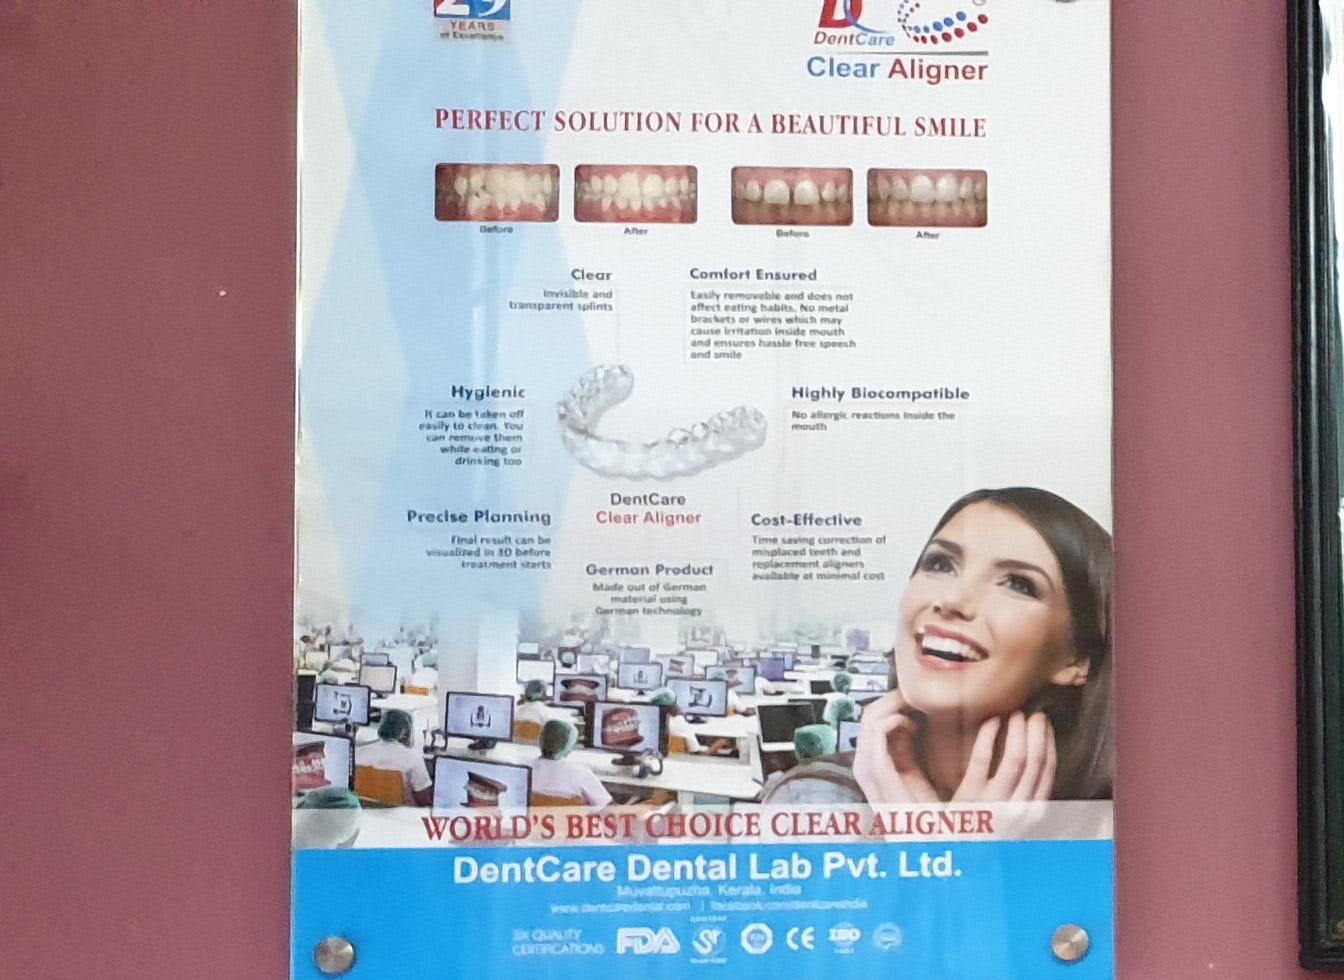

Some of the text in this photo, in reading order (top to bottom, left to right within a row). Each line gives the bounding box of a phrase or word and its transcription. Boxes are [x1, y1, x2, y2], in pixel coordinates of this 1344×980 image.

[450, 21, 495, 32] YEARS
[813, 31, 895, 47] DentCare
[807, 57, 989, 85] Clear Aligner
[435, 108, 987, 138] PERFECT SOLUTION FOR A BEAUTIFUL SMILE
[623, 226, 648, 236] After
[915, 230, 940, 240] After
[571, 268, 612, 281] Clear
[690, 268, 817, 281] Comfort Ensured
[543, 289, 613, 300] Invisible and
[690, 291, 853, 302] Easily removable and does not
[508, 301, 613, 312] transparent splints
[690, 302, 720, 312] affect
[724, 303, 757, 314] eating
[800, 304, 815, 312] No
[818, 304, 848, 312] metal
[691, 314, 842, 326] brackets or wires which may
[691, 326, 845, 336] cause irritation inside mouth
[691, 338, 856, 350] and ensures hassle free speech
[691, 350, 742, 359] and smile
[451, 385, 525, 401] Hygienic
[791, 386, 970, 402] Highly Biocompatible
[610, 492, 686, 507] DentCare
[407, 510, 551, 526] Precise Planning
[595, 511, 701, 527] Clear Aligner
[751, 514, 862, 527] Cost-Effective
[586, 564, 714, 576] German Product
[421, 810, 994, 841] WORLD'S BEST CHOICE CLEAR ALIGNER
[454, 851, 962, 884] DentCare Dental Lab Pvt. Ltd.
[770, 884, 801, 895] India
[617, 927, 680, 954] FDA
[787, 927, 815, 950] CE
